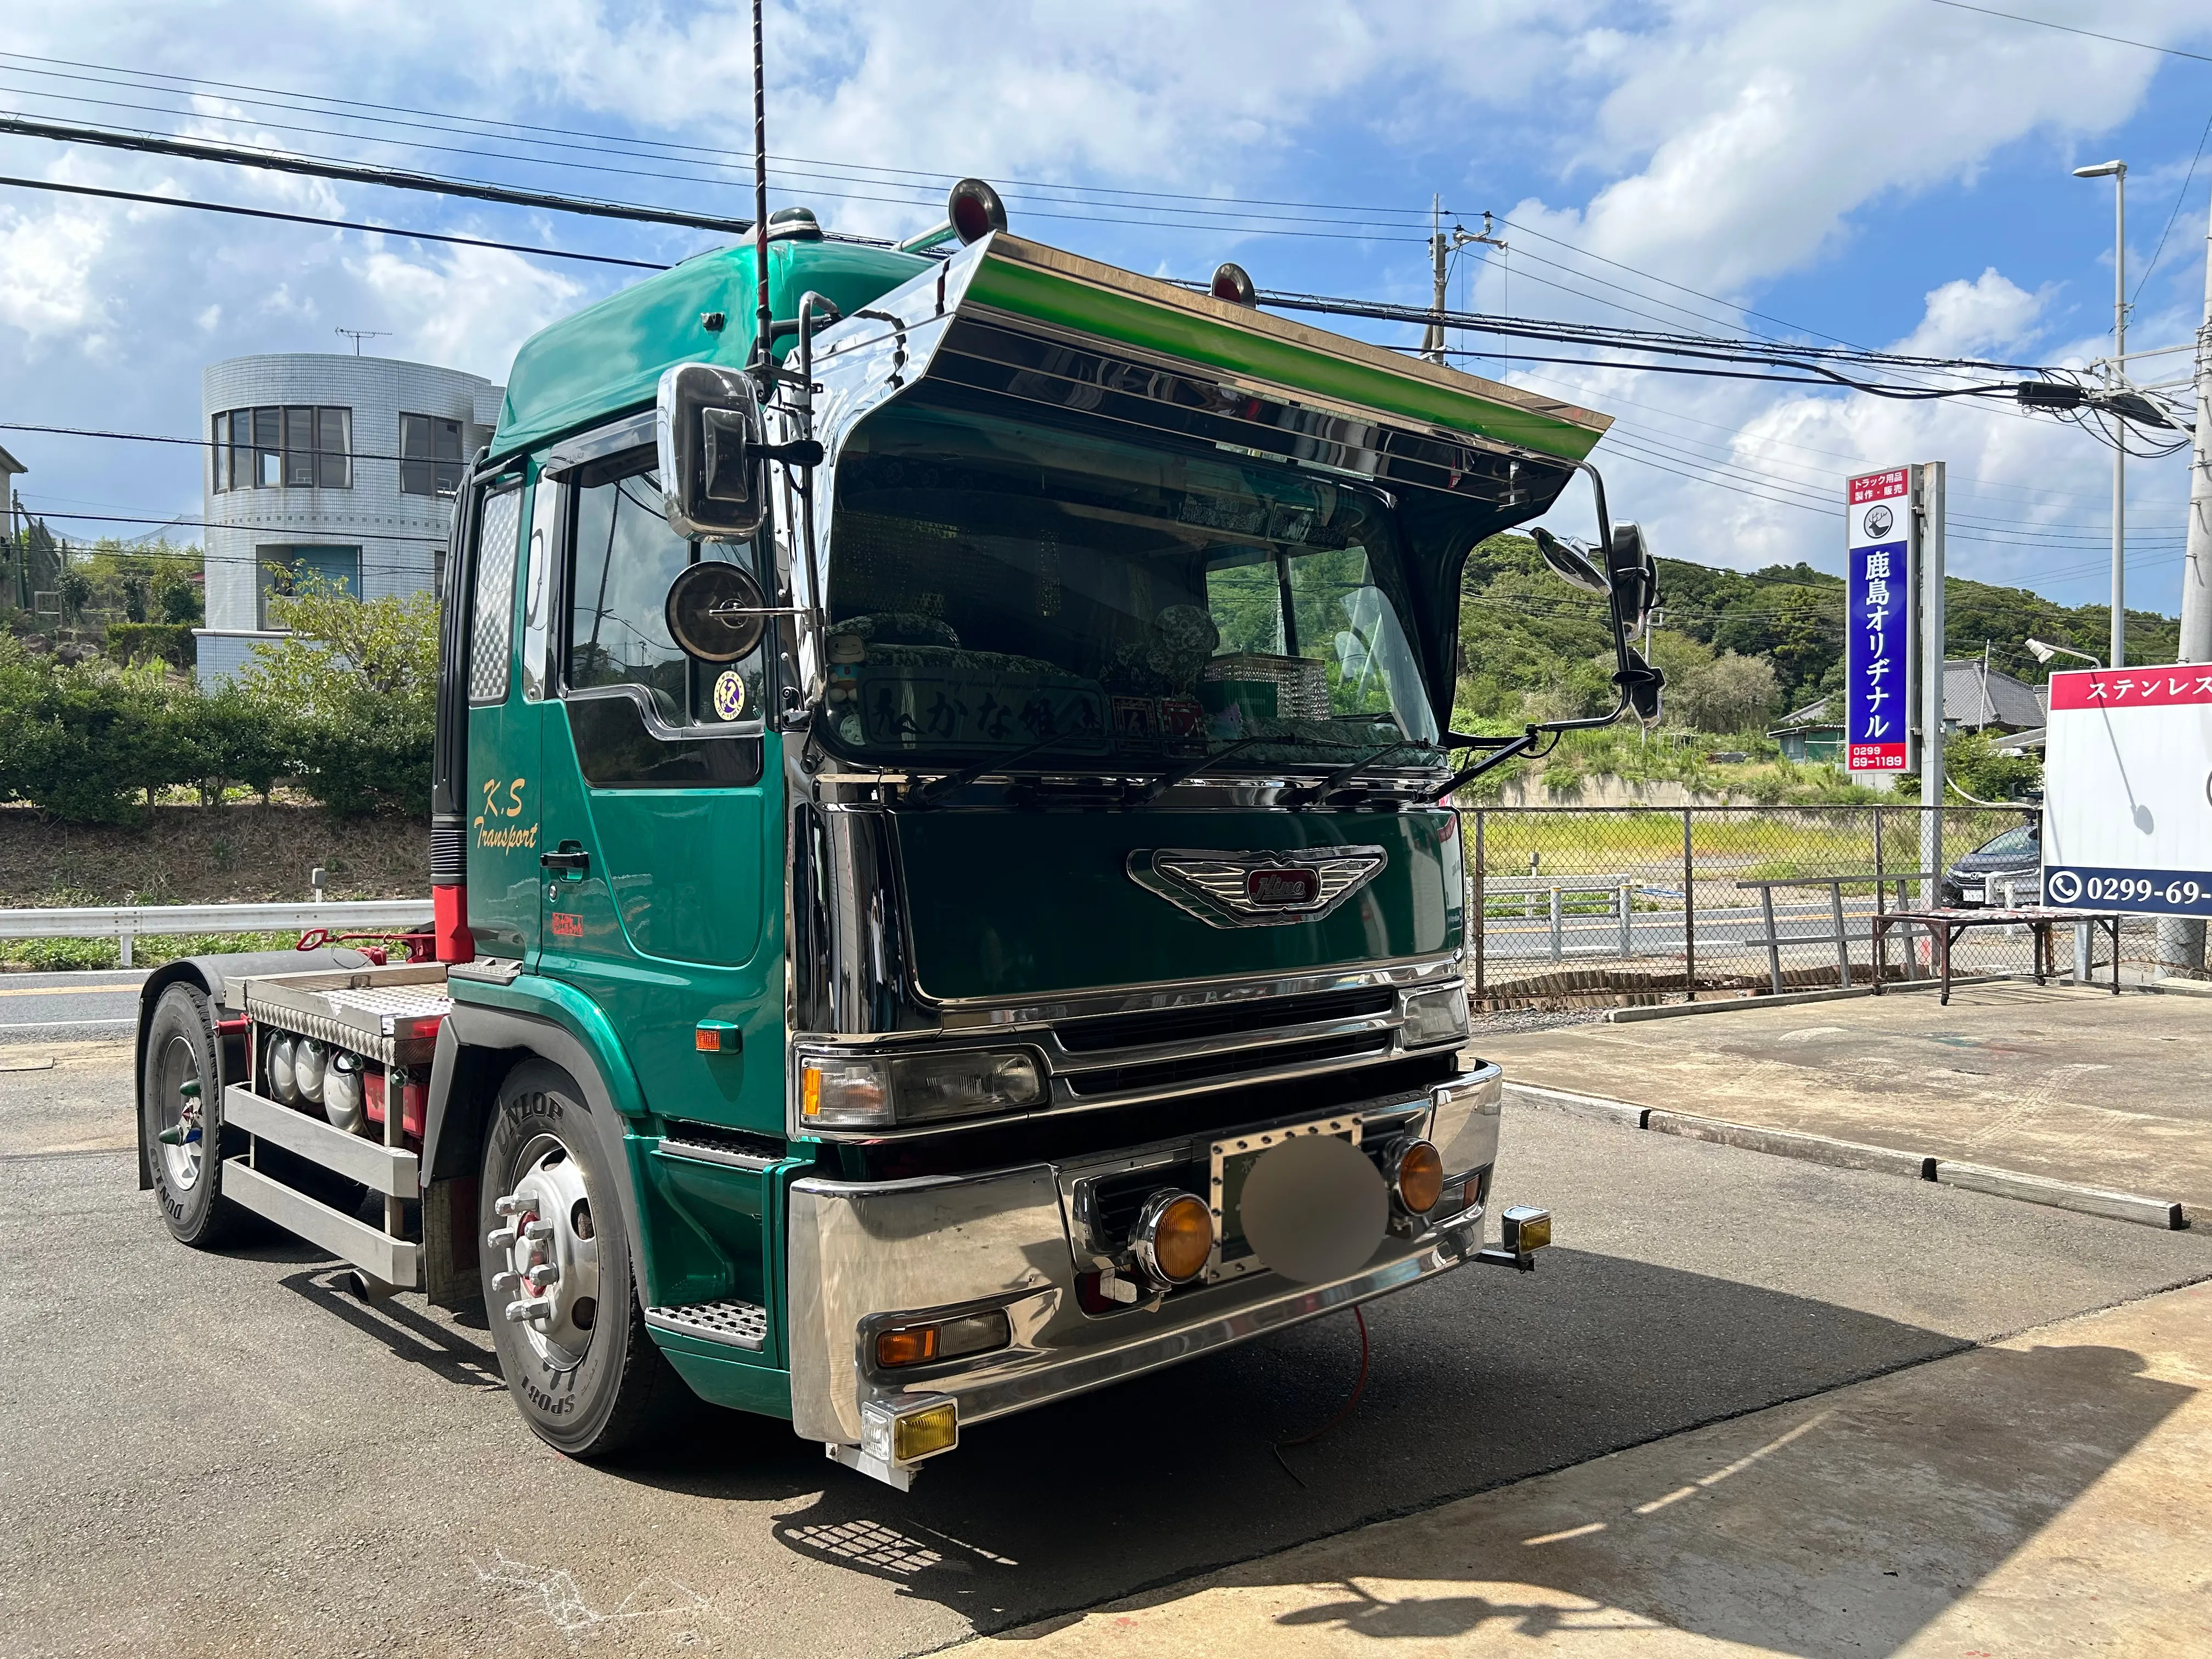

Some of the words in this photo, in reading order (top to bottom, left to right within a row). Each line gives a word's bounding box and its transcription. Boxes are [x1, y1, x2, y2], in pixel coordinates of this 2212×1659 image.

[1854, 471, 1903, 490] トラック用品
[1854, 484, 1903, 501] 製作・販売
[1864, 550, 1891, 740] 鹿島オリヂナル
[2086, 676, 2212, 701] ステンレス
[1852, 756, 1903, 768] 69-1189
[1853, 746, 1881, 756] 0299
[483, 778, 526, 817] K.S
[473, 816, 539, 857] Transport
[1251, 873, 1306, 901] Hino
[2086, 877, 2212, 905] 0299-69-
[487, 1091, 565, 1192] DUNLOP
